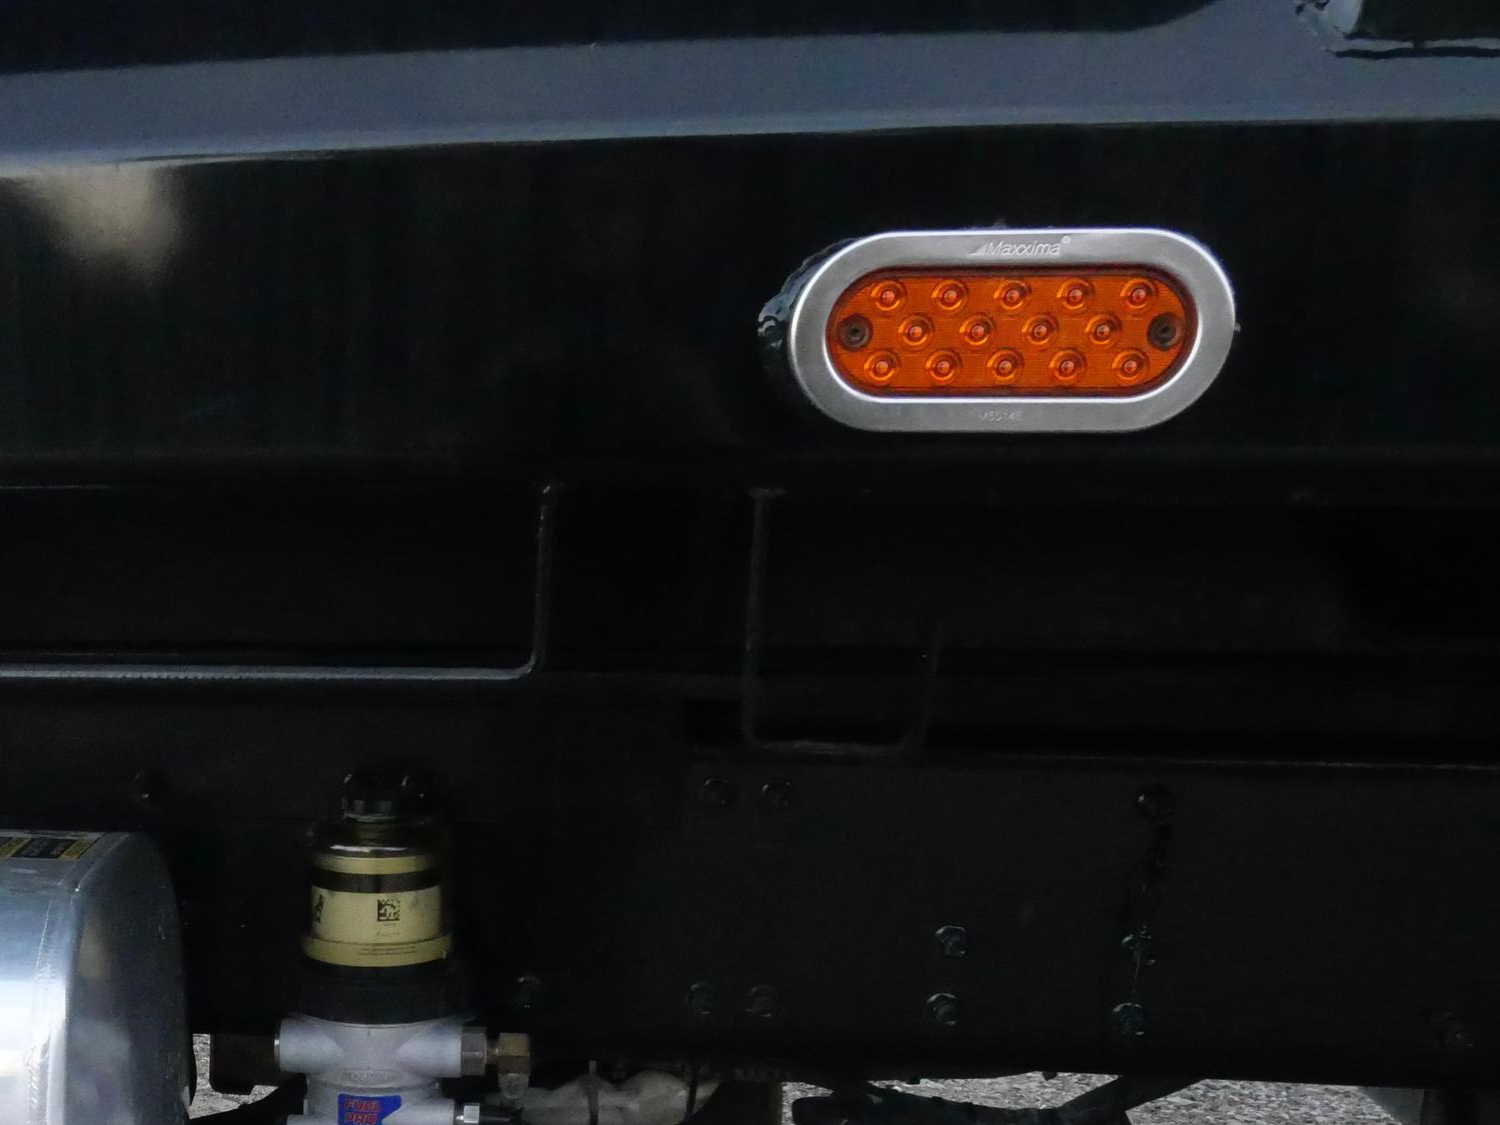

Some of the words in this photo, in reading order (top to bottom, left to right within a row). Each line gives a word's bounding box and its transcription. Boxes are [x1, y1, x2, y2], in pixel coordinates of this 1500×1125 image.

[986, 240, 1060, 257] Maxxima
[344, 1099, 380, 1112] FUEL
[344, 1112, 377, 1125] PRO
